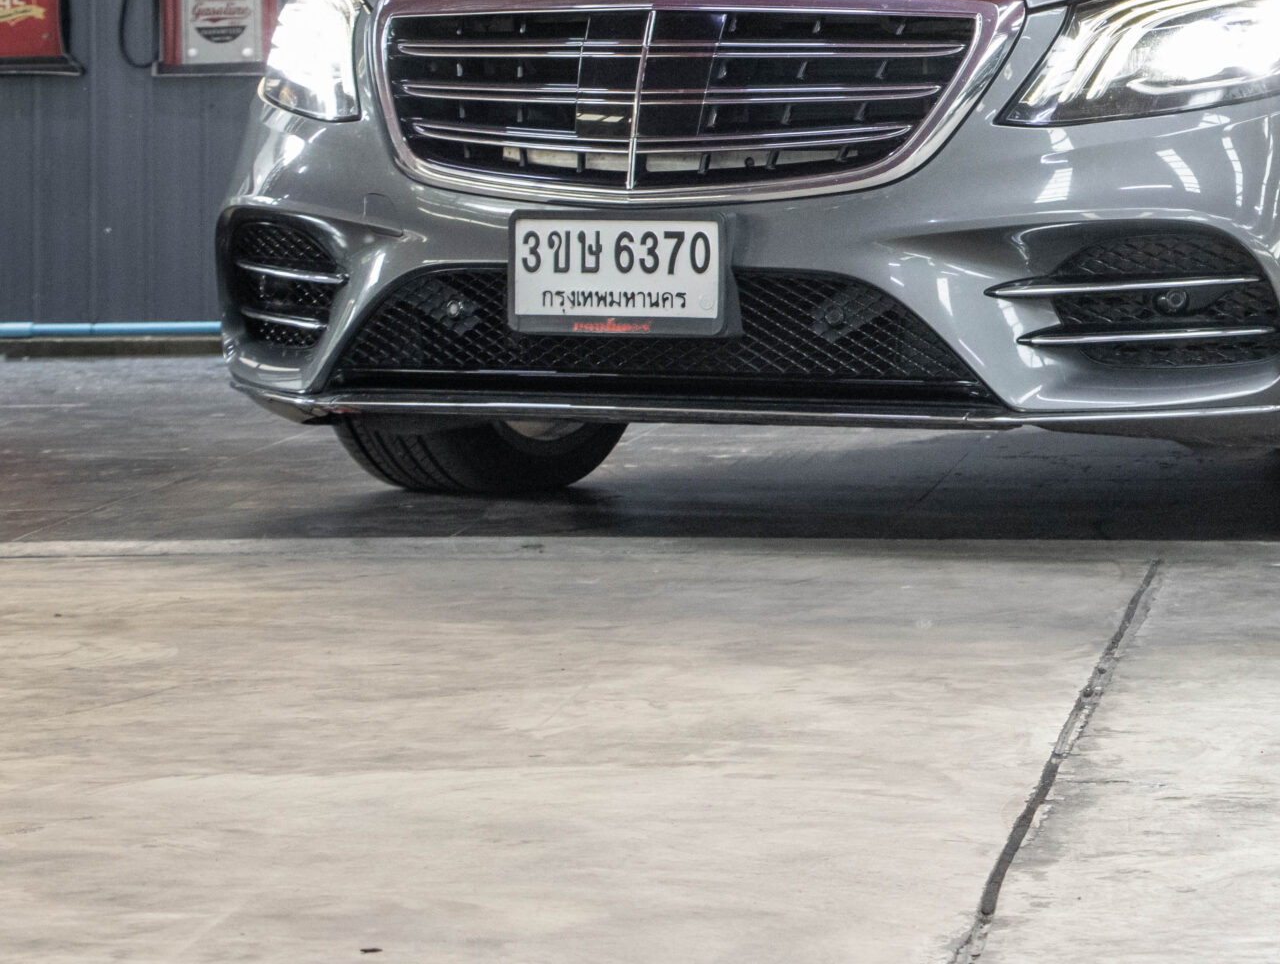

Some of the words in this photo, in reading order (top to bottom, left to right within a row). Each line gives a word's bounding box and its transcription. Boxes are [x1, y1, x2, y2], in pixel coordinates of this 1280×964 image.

[521, 229, 603, 274] 3ขษ
[613, 230, 712, 275] 6370
[541, 289, 687, 314] กรุงเทพมหานคร
